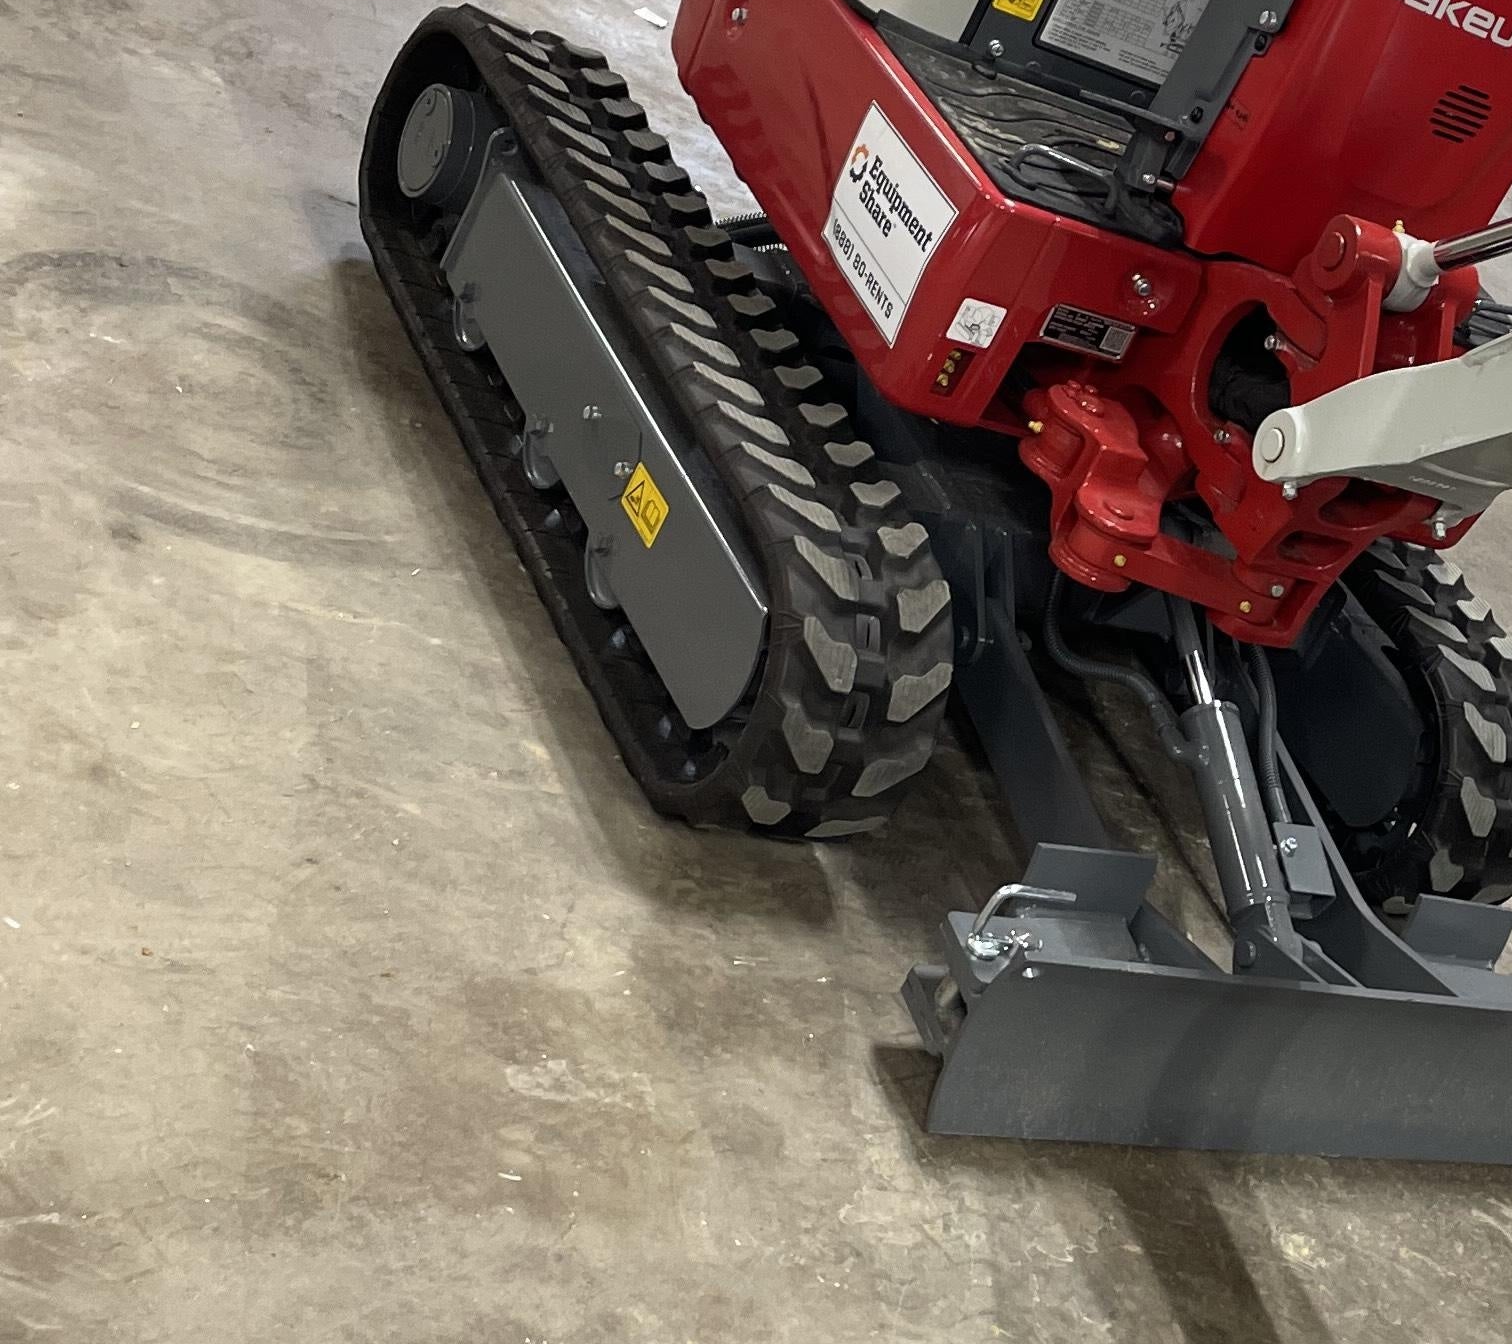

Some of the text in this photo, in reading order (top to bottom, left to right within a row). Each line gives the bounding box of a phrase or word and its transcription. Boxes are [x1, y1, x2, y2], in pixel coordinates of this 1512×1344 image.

[858, 180, 892, 238] Share
[868, 154, 933, 253] Equipment
[832, 217, 894, 319] (888) 80-RENTS
